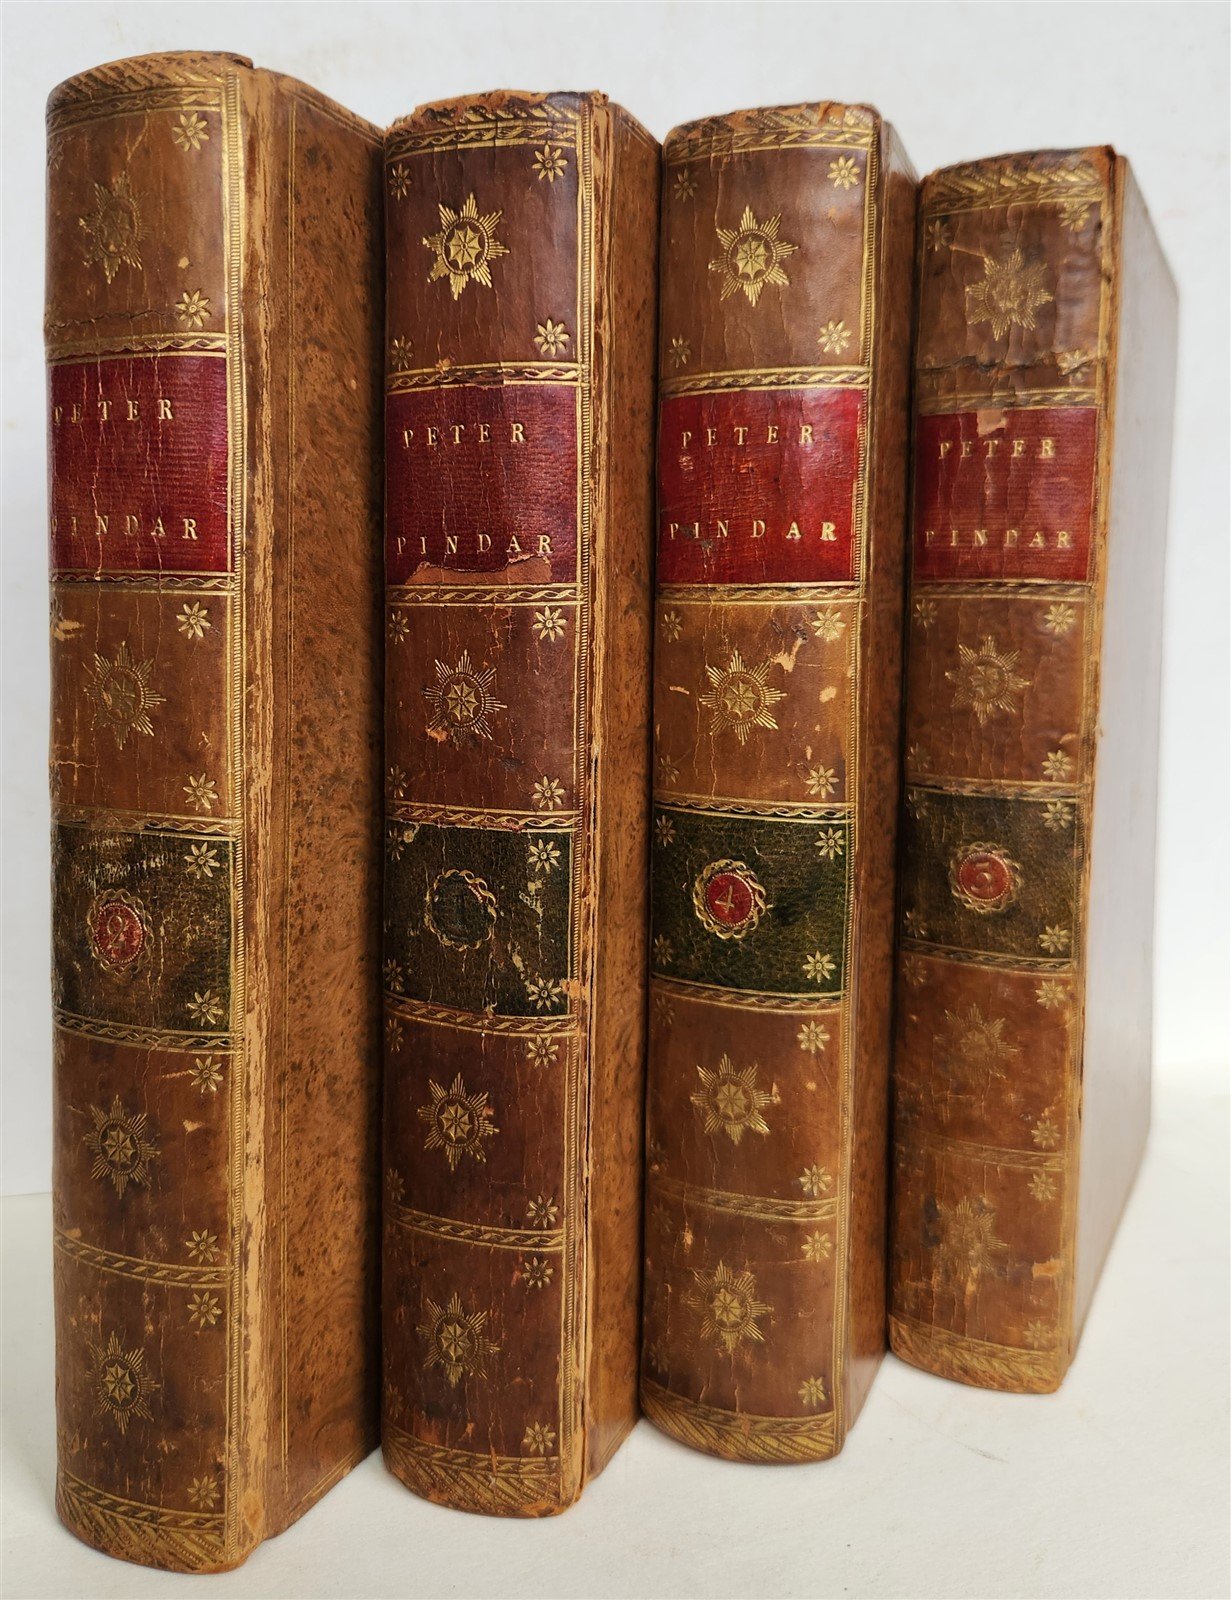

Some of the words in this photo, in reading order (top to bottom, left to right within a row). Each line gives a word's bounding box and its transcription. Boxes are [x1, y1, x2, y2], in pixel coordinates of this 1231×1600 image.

[53, 399, 174, 426] PETER
[403, 423, 526, 449] PETER
[681, 424, 815, 449] PETER
[938, 438, 1057, 460] PETER
[669, 520, 838, 542] PINDAR
[397, 533, 553, 555] PINDAR
[714, 885, 735, 914] 4
[107, 915, 126, 949] 2
